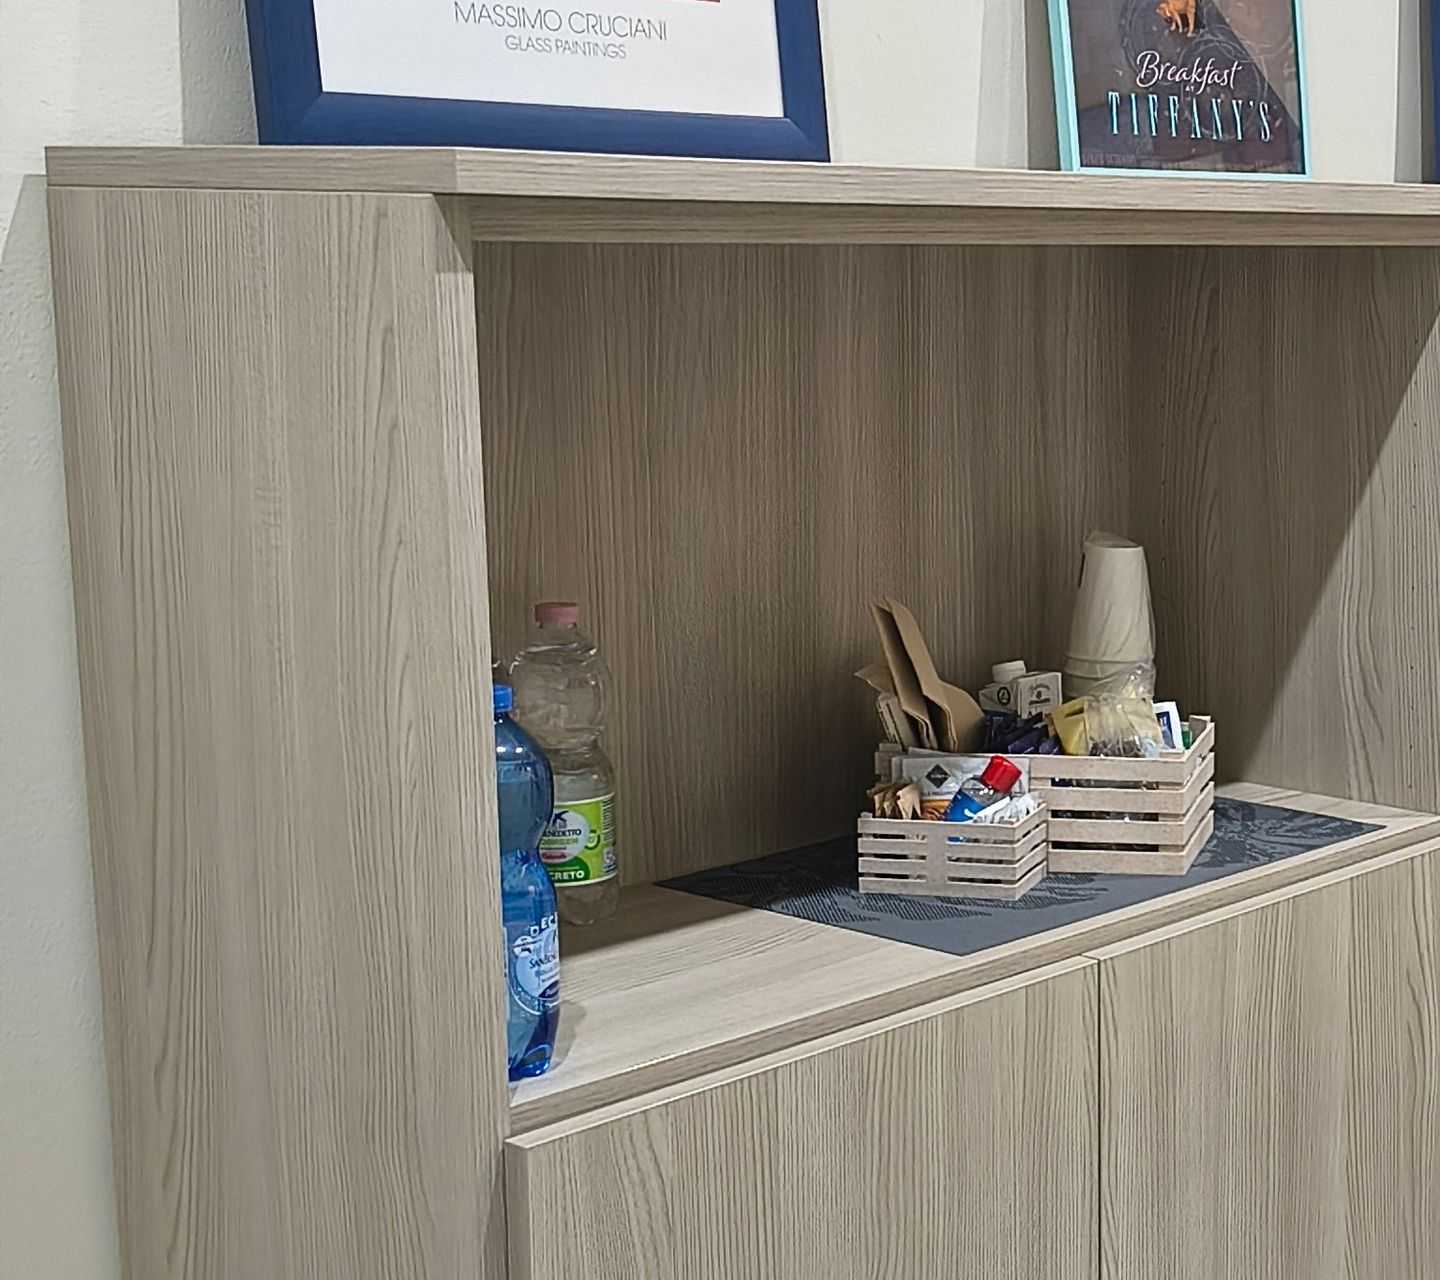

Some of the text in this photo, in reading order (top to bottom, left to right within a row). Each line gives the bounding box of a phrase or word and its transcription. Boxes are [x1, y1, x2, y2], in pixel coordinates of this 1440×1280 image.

[454, 1, 668, 41] MASSIMO CRUCIANI
[505, 35, 627, 59] GLASS PAINTINGS
[1136, 50, 1243, 95] Breakfast
[1108, 91, 1271, 143] TIFFANY'S
[549, 870, 585, 880] CRETO
